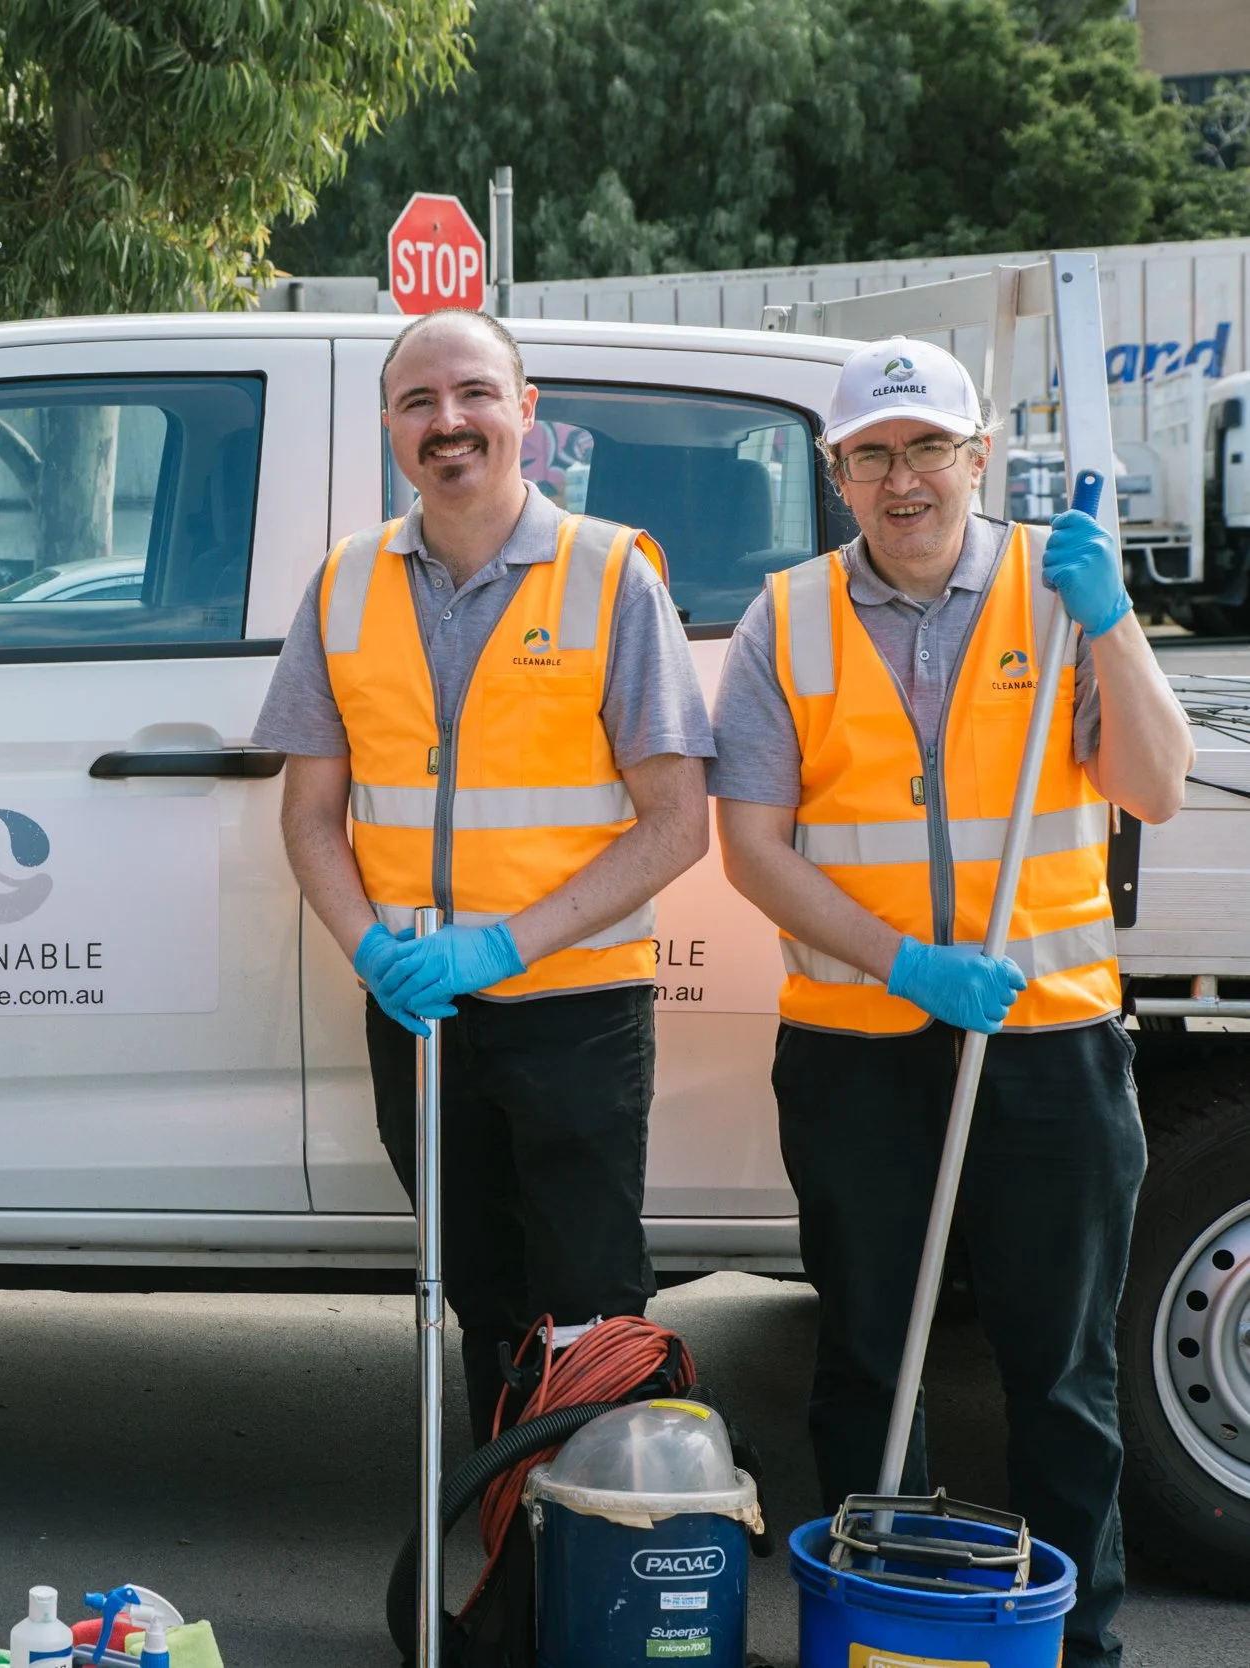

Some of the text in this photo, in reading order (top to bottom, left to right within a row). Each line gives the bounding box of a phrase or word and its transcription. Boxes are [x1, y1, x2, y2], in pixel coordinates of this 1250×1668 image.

[396, 239, 479, 298] STOP
[1053, 321, 1232, 388] and
[872, 385, 927, 397] CLEANABLE
[512, 657, 562, 666] CLEANABLE
[650, 1627, 709, 1640] Superpro
